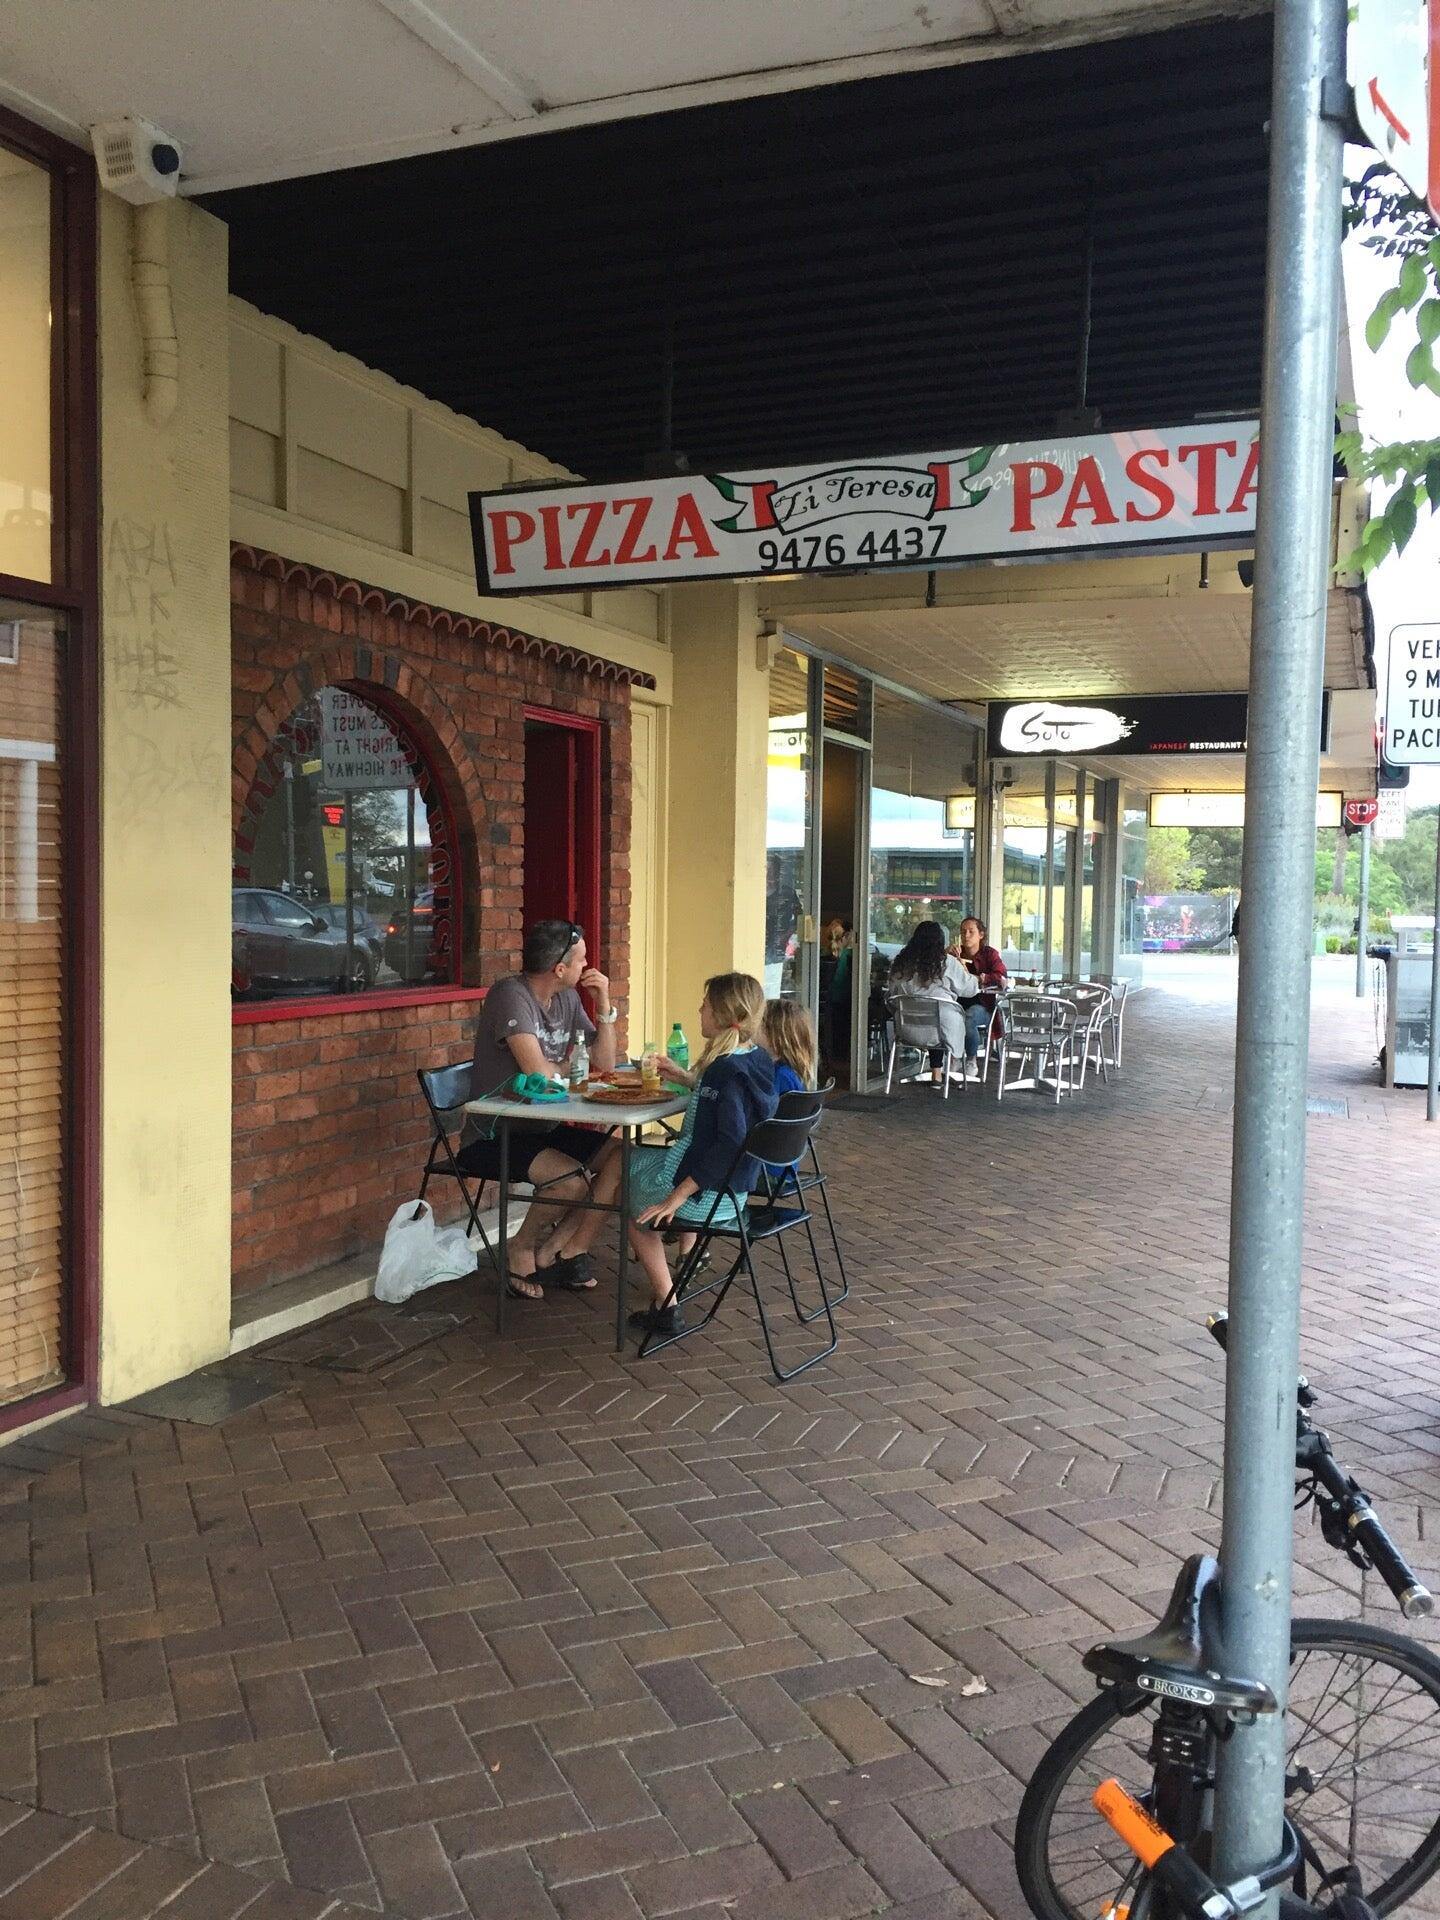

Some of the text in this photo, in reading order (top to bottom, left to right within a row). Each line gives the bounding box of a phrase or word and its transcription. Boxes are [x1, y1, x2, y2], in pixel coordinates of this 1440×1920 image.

[826, 477, 936, 502] Teresa
[487, 493, 720, 575] PIZZA
[759, 525, 947, 571] 9476 4437
[1407, 640, 1440, 659] VE
[1405, 669, 1417, 689] 9
[1408, 699, 1440, 719] TU
[1189, 741, 1243, 750] RESTAURANT
[1153, 1679, 1198, 1699] BROOKS
